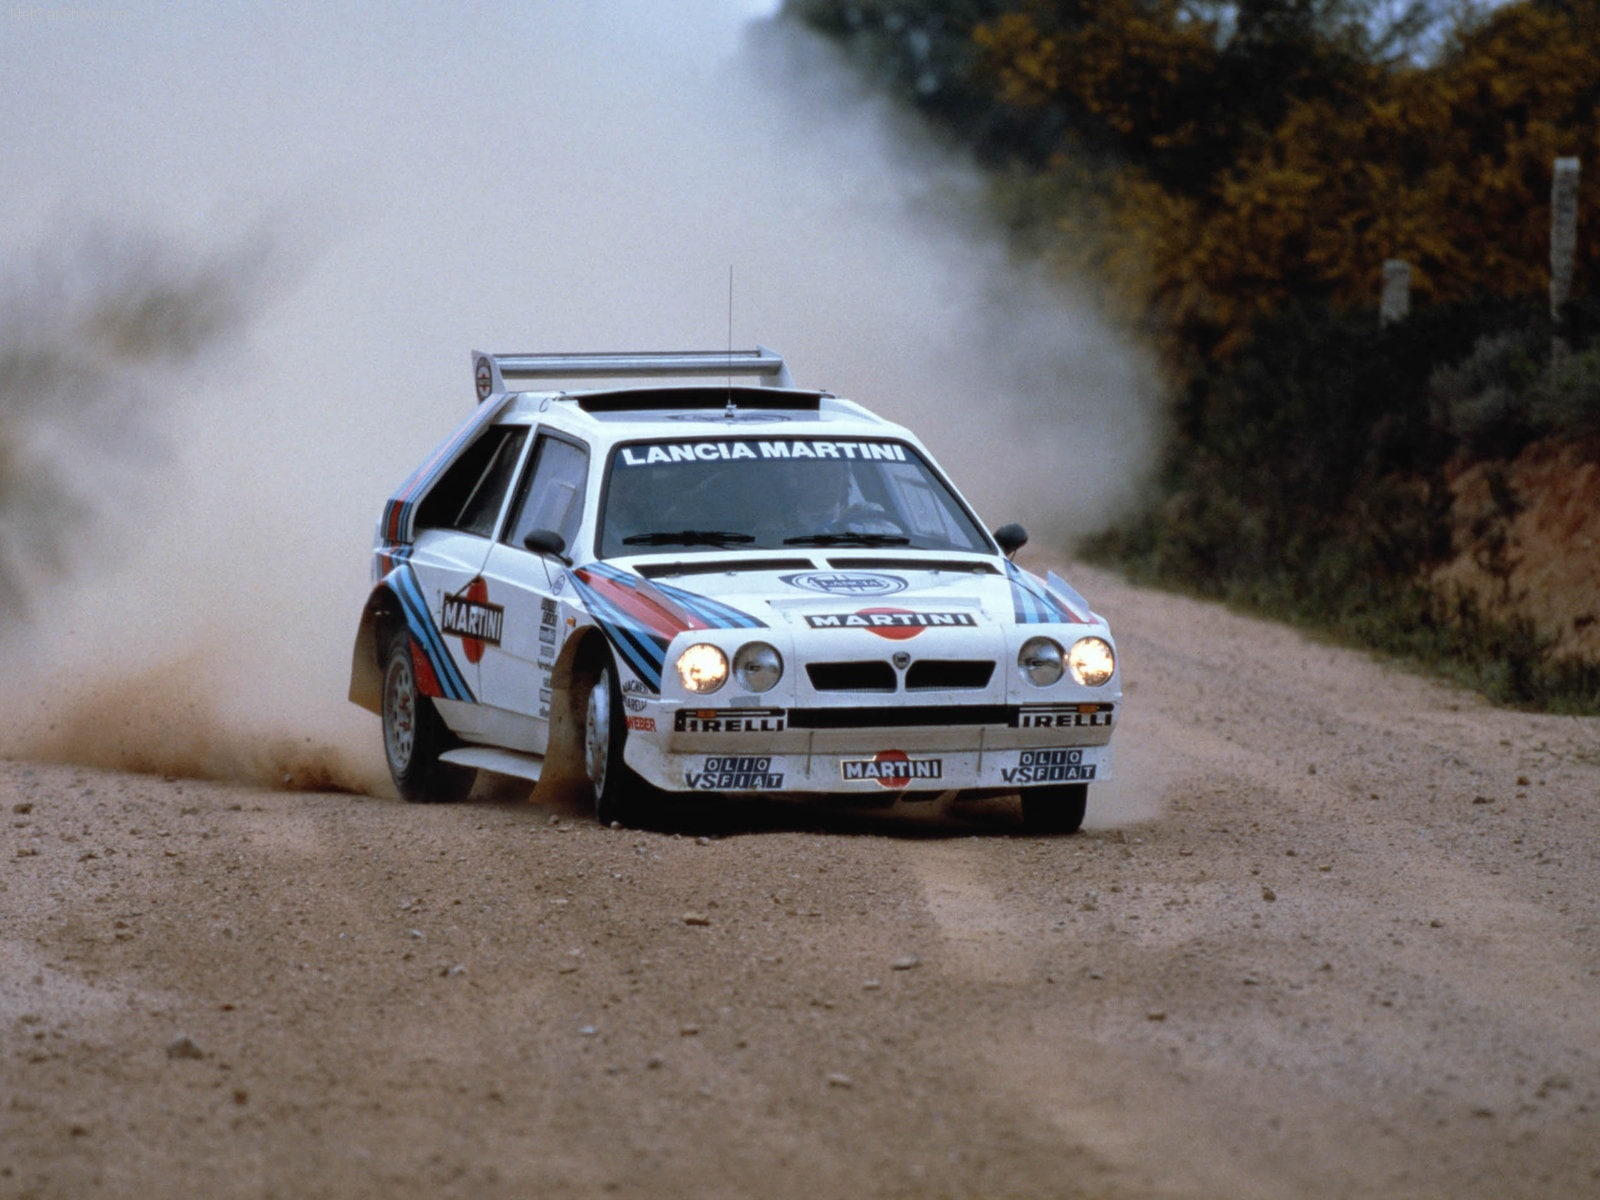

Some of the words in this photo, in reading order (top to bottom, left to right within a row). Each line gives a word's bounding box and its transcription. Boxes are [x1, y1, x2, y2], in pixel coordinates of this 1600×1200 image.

[621, 442, 756, 465] LANCIA
[758, 441, 906, 461] MARTINI
[444, 601, 502, 641] MARTINI
[811, 613, 967, 627] MARTINI
[625, 716, 656, 732] WEBER
[705, 758, 771, 772] OLIO
[1020, 751, 1082, 766] OLIO
[845, 761, 939, 778] MARTINI
